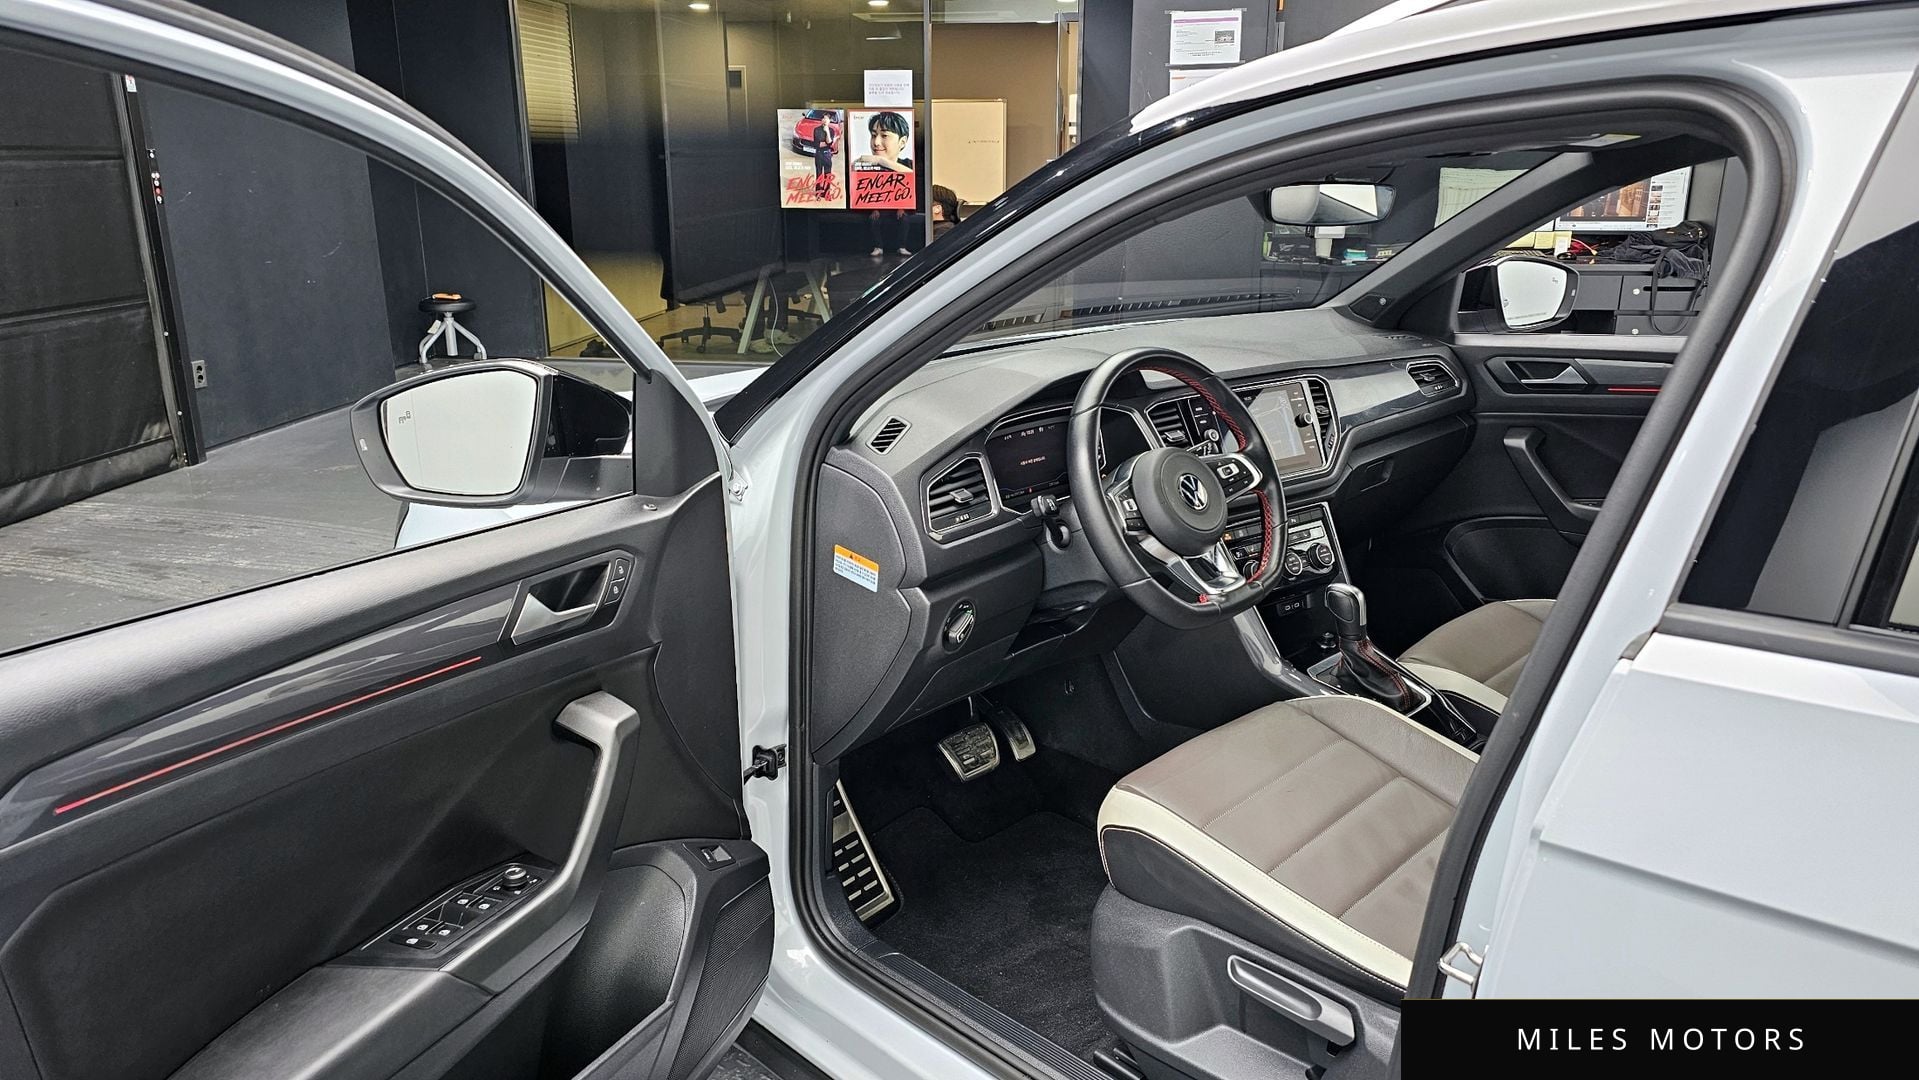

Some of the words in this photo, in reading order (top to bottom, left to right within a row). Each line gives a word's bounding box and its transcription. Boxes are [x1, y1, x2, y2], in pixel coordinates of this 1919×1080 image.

[856, 173, 910, 191] ENCAR.
[855, 190, 892, 205] MEET.
[894, 187, 912, 201] GO.
